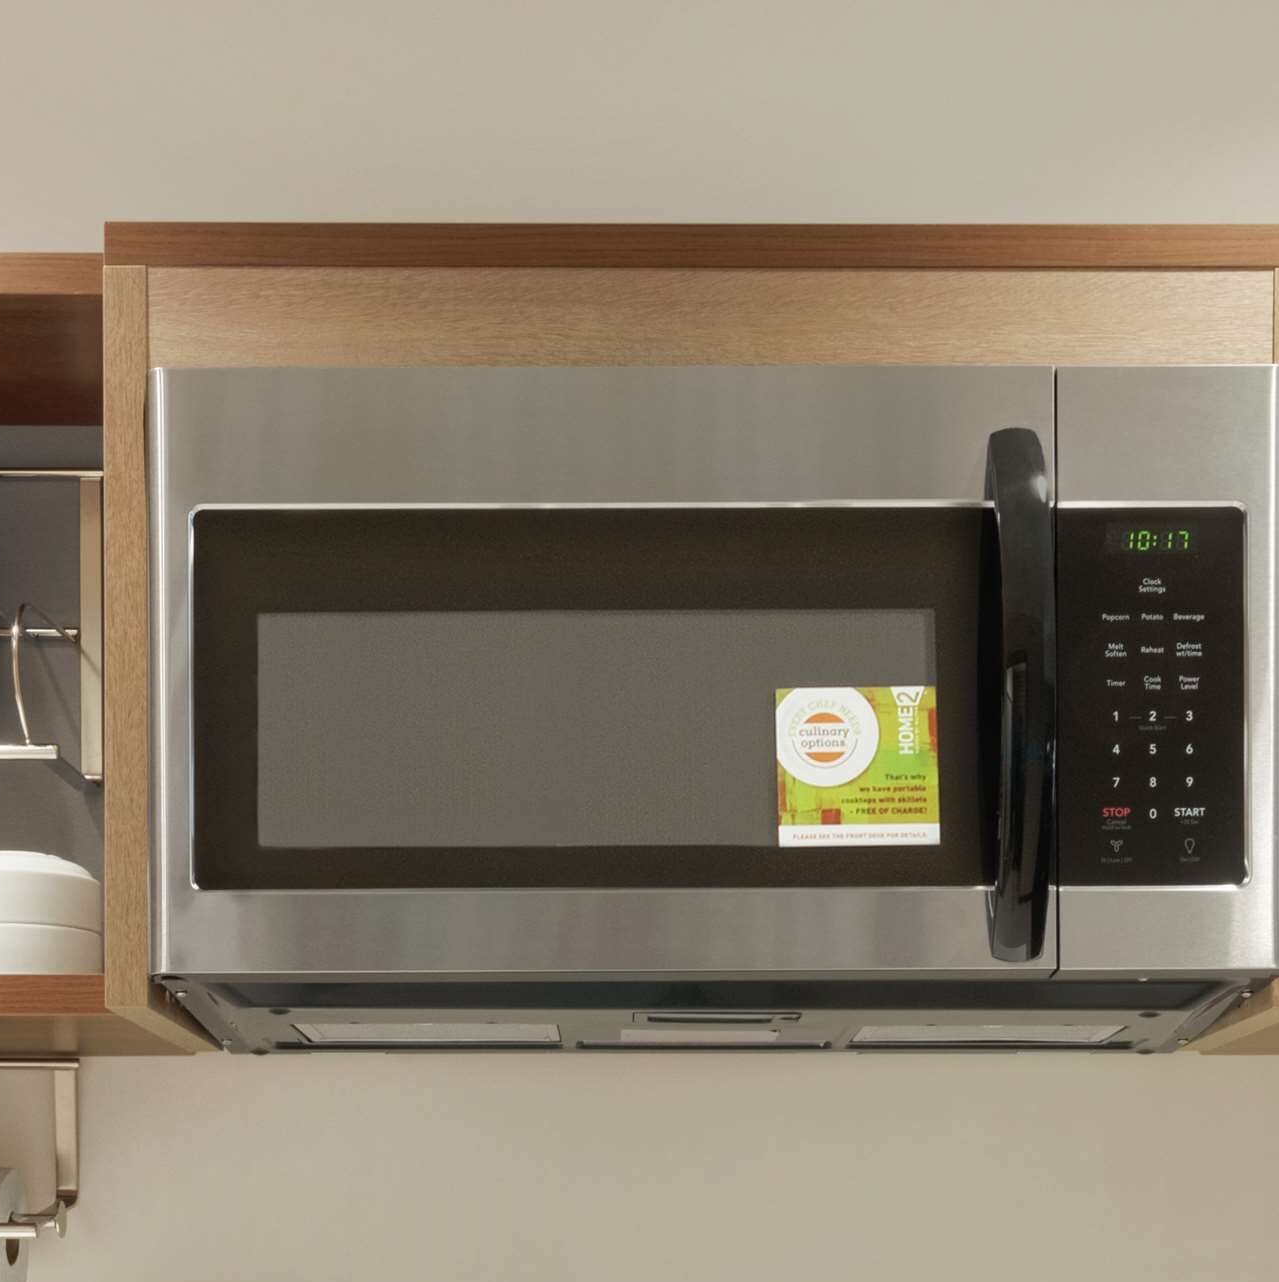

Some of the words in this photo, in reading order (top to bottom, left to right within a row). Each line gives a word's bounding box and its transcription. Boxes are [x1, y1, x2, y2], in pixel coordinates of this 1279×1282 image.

[1128, 530, 1190, 551] 10:17
[1142, 577, 1162, 585] Clock
[1138, 585, 1166, 594] Settings
[1102, 613, 1130, 621] Popcorn
[1141, 613, 1164, 621] Potato
[1173, 613, 1205, 622] Beverage
[1141, 646, 1164, 654] Reheat
[1106, 679, 1126, 687] Timer
[1112, 711, 1119, 722] 1
[1148, 710, 1157, 722] 2
[1185, 710, 1193, 722] 3
[799, 726, 850, 738] culinary
[801, 738, 846, 750] options
[1112, 744, 1120, 755] 4
[1149, 744, 1157, 755] 5
[1185, 744, 1194, 755] 6
[1112, 777, 1120, 788] 7
[1148, 777, 1157, 788] 8
[1185, 776, 1194, 788] 9
[893, 785, 927, 794] portable
[1102, 808, 1131, 817] STOP
[1148, 808, 1157, 820] 0
[1174, 807, 1206, 817] START
